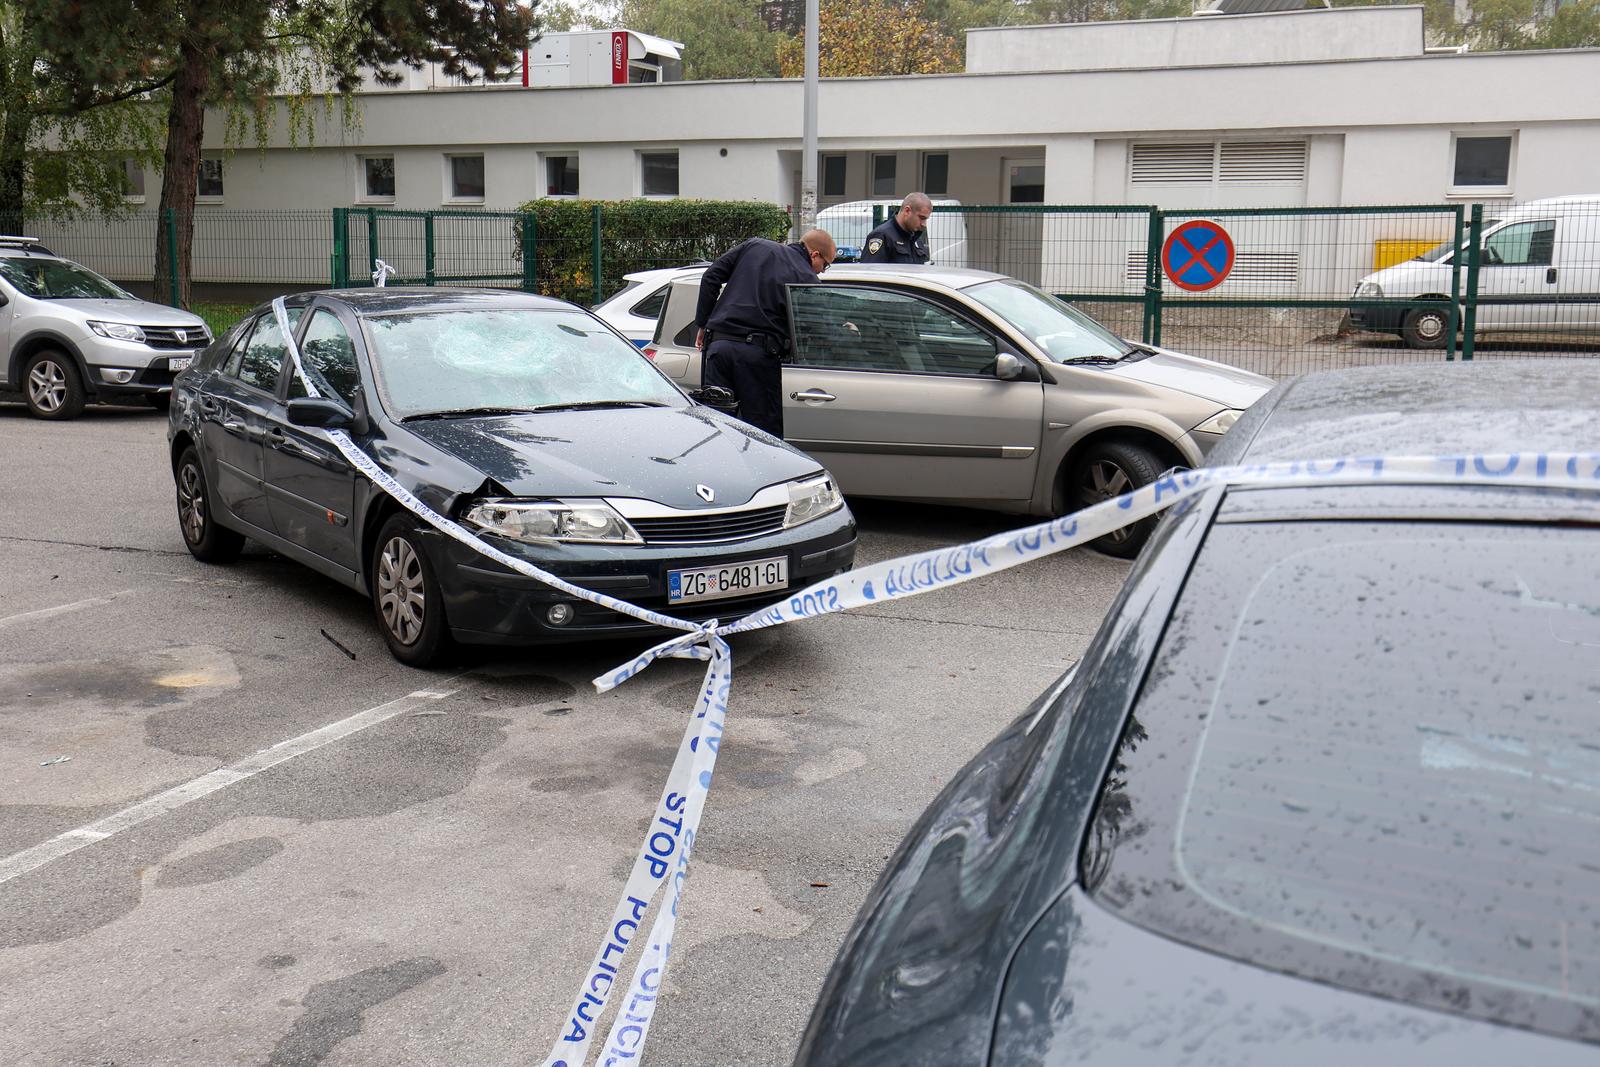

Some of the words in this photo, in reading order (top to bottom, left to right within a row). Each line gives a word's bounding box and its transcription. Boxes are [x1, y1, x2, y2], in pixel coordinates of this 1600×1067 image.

[670, 589, 681, 597] HR
[683, 572, 706, 596] ZG
[644, 792, 687, 879] STOP
[563, 896, 648, 1042] POLICIJA
